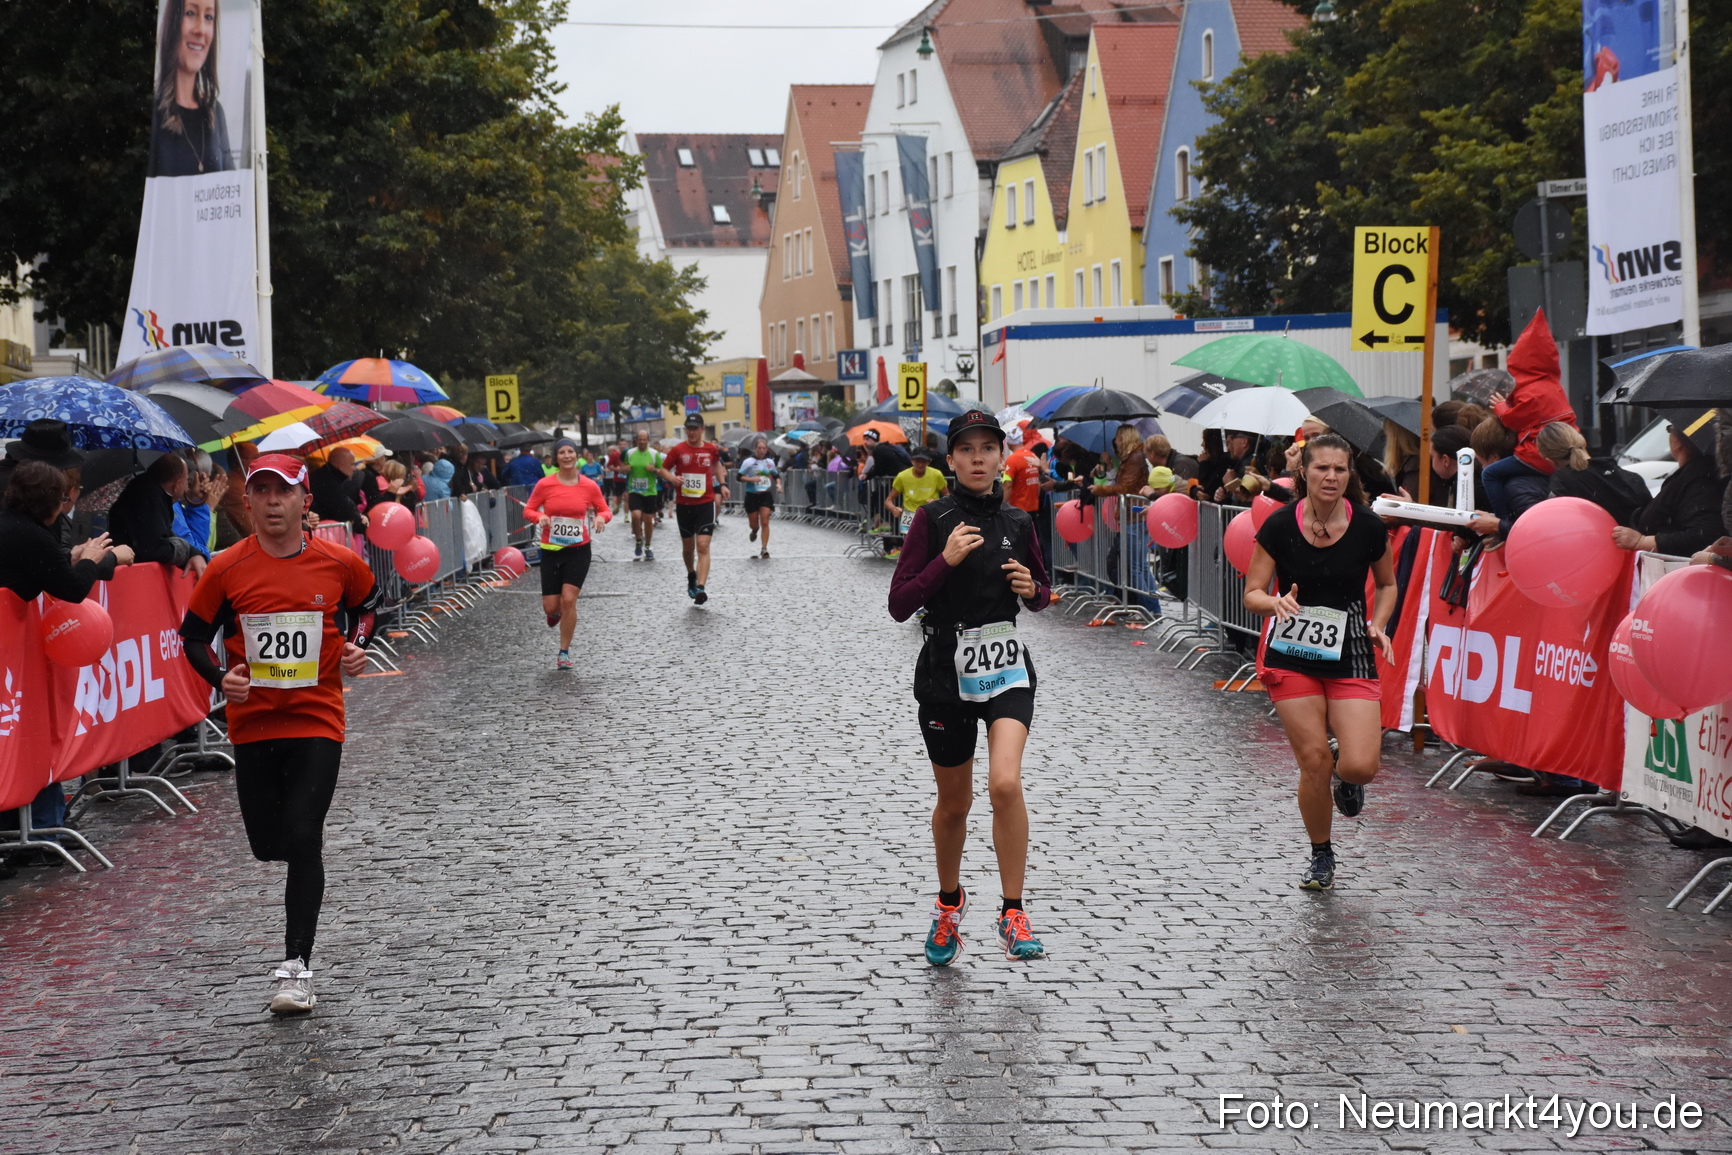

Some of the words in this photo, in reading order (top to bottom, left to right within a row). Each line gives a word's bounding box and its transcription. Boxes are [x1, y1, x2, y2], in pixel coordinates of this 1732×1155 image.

[1364, 231, 1429, 254] Block
[1017, 250, 1037, 273] HOTEL
[1372, 263, 1415, 326] C
[901, 364, 924, 374] Block
[489, 377, 515, 387] Block
[905, 376, 920, 400] D
[495, 389, 511, 413] D
[685, 479, 702, 489] 335
[553, 523, 581, 537] 2023
[275, 615, 315, 625] BOCK
[982, 623, 1015, 637] BOCK
[1280, 616, 1339, 648] 2733
[257, 630, 308, 660] 280
[1286, 645, 1323, 661] Melanie
[963, 638, 1019, 674] 2429
[269, 665, 298, 678] Oliver
